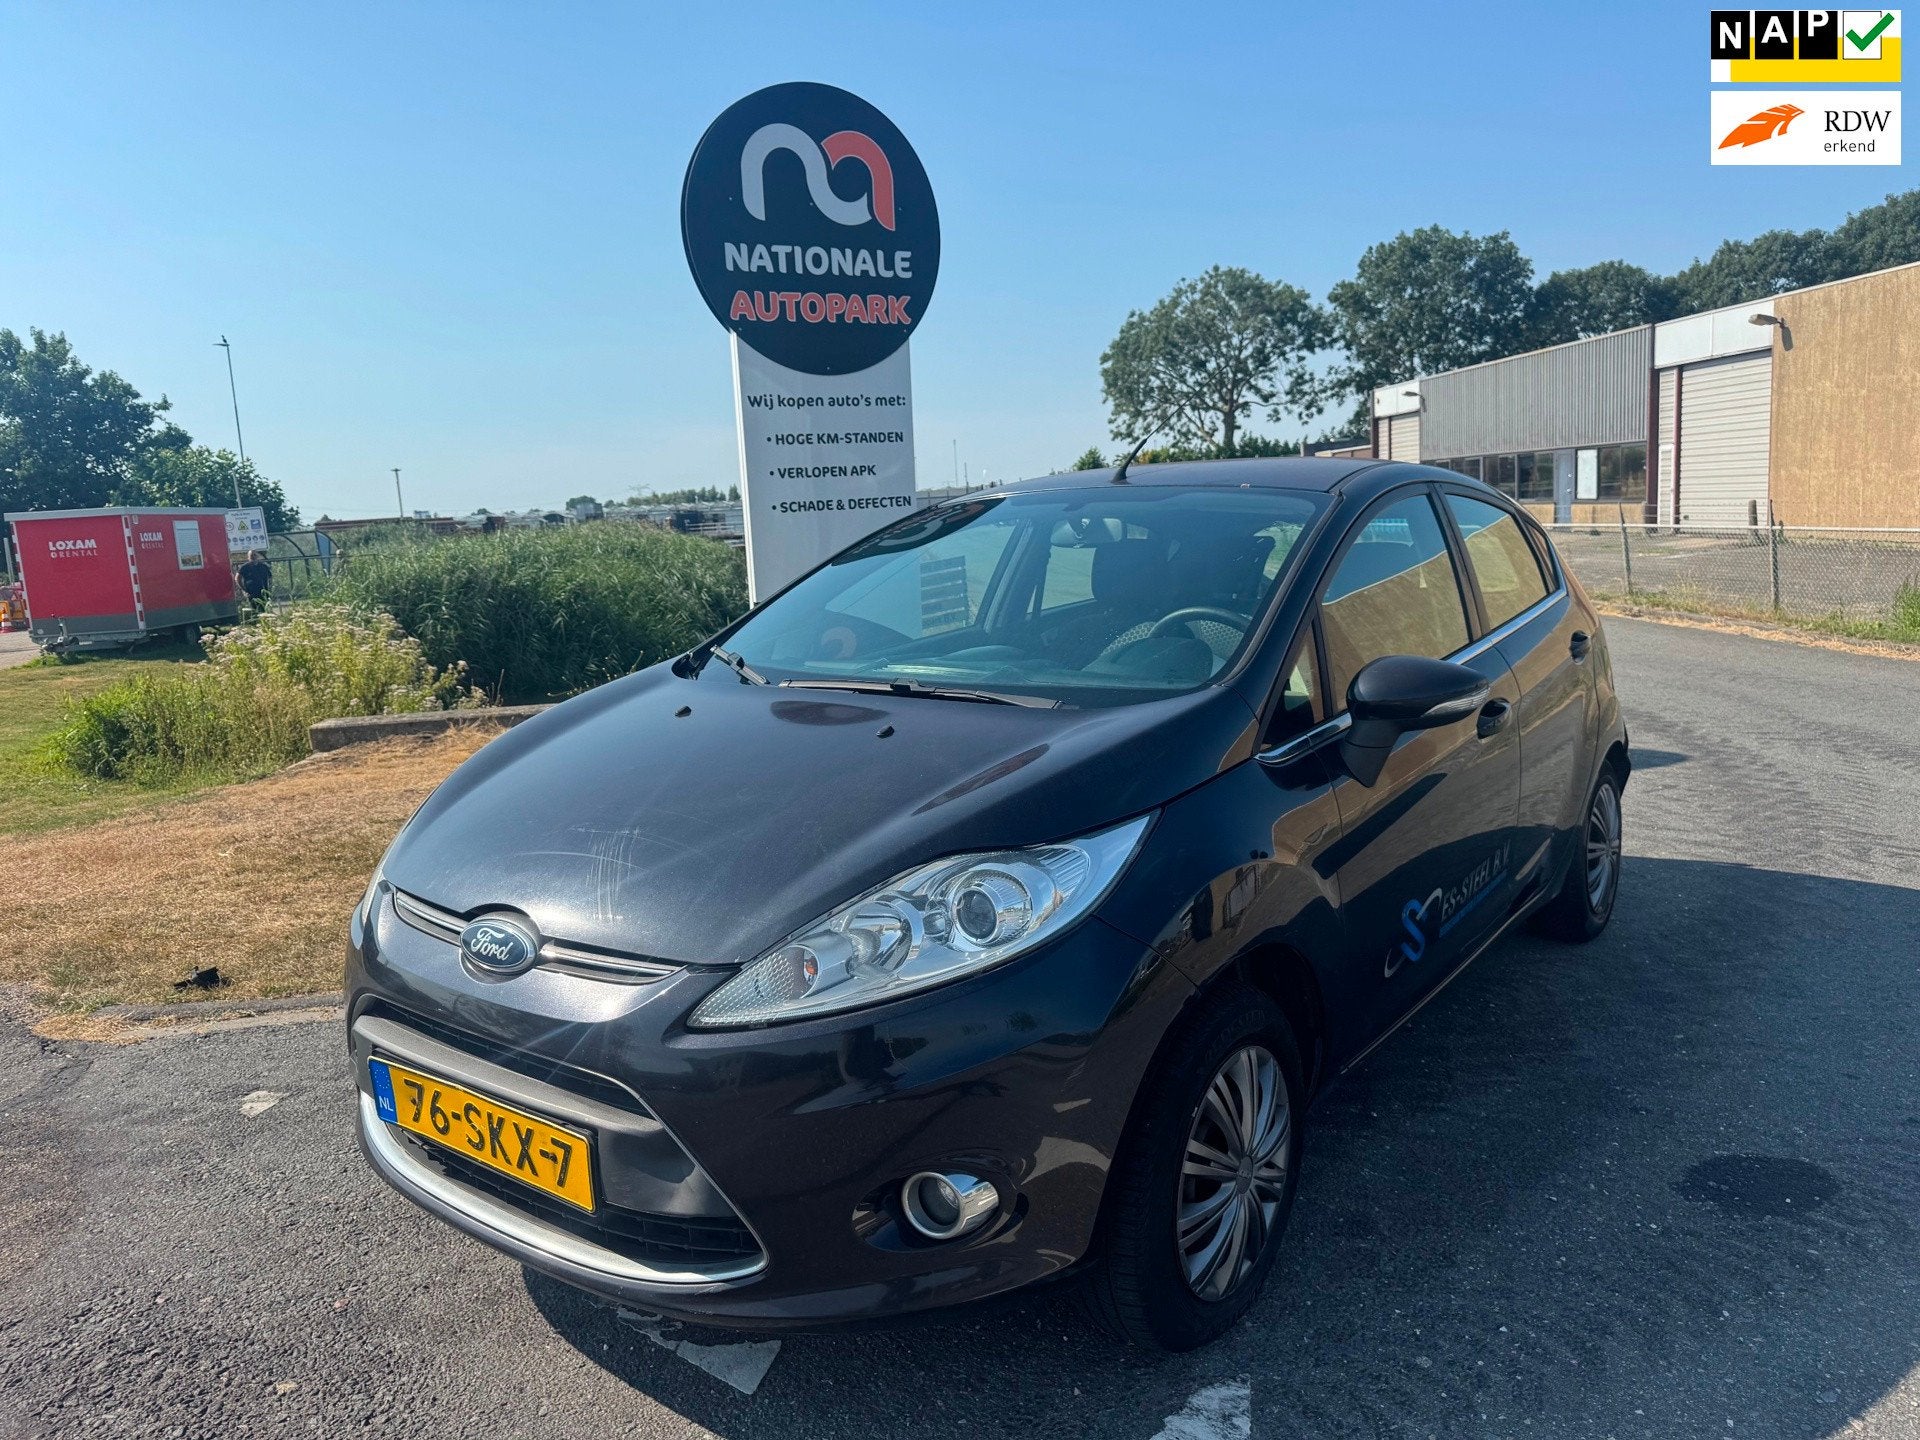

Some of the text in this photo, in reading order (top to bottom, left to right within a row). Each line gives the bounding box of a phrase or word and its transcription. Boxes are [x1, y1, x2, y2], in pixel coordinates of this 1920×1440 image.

[724, 242, 912, 279] NATIONALE
[730, 290, 912, 325] AUTOPARK
[747, 394, 906, 410] Wij kopen auto's met:
[775, 431, 904, 445] HOGE KM-STANDEN
[777, 464, 877, 479] VERLOPEN APK
[780, 496, 912, 513] SCHADE & DEFECTEN
[48, 538, 97, 551] LOXAM
[139, 532, 163, 542] LOXAM
[59, 549, 98, 559] RENTAL
[471, 927, 514, 961] Ford
[379, 1095, 394, 1112] NL
[403, 1076, 573, 1189] 76-SKX-7
